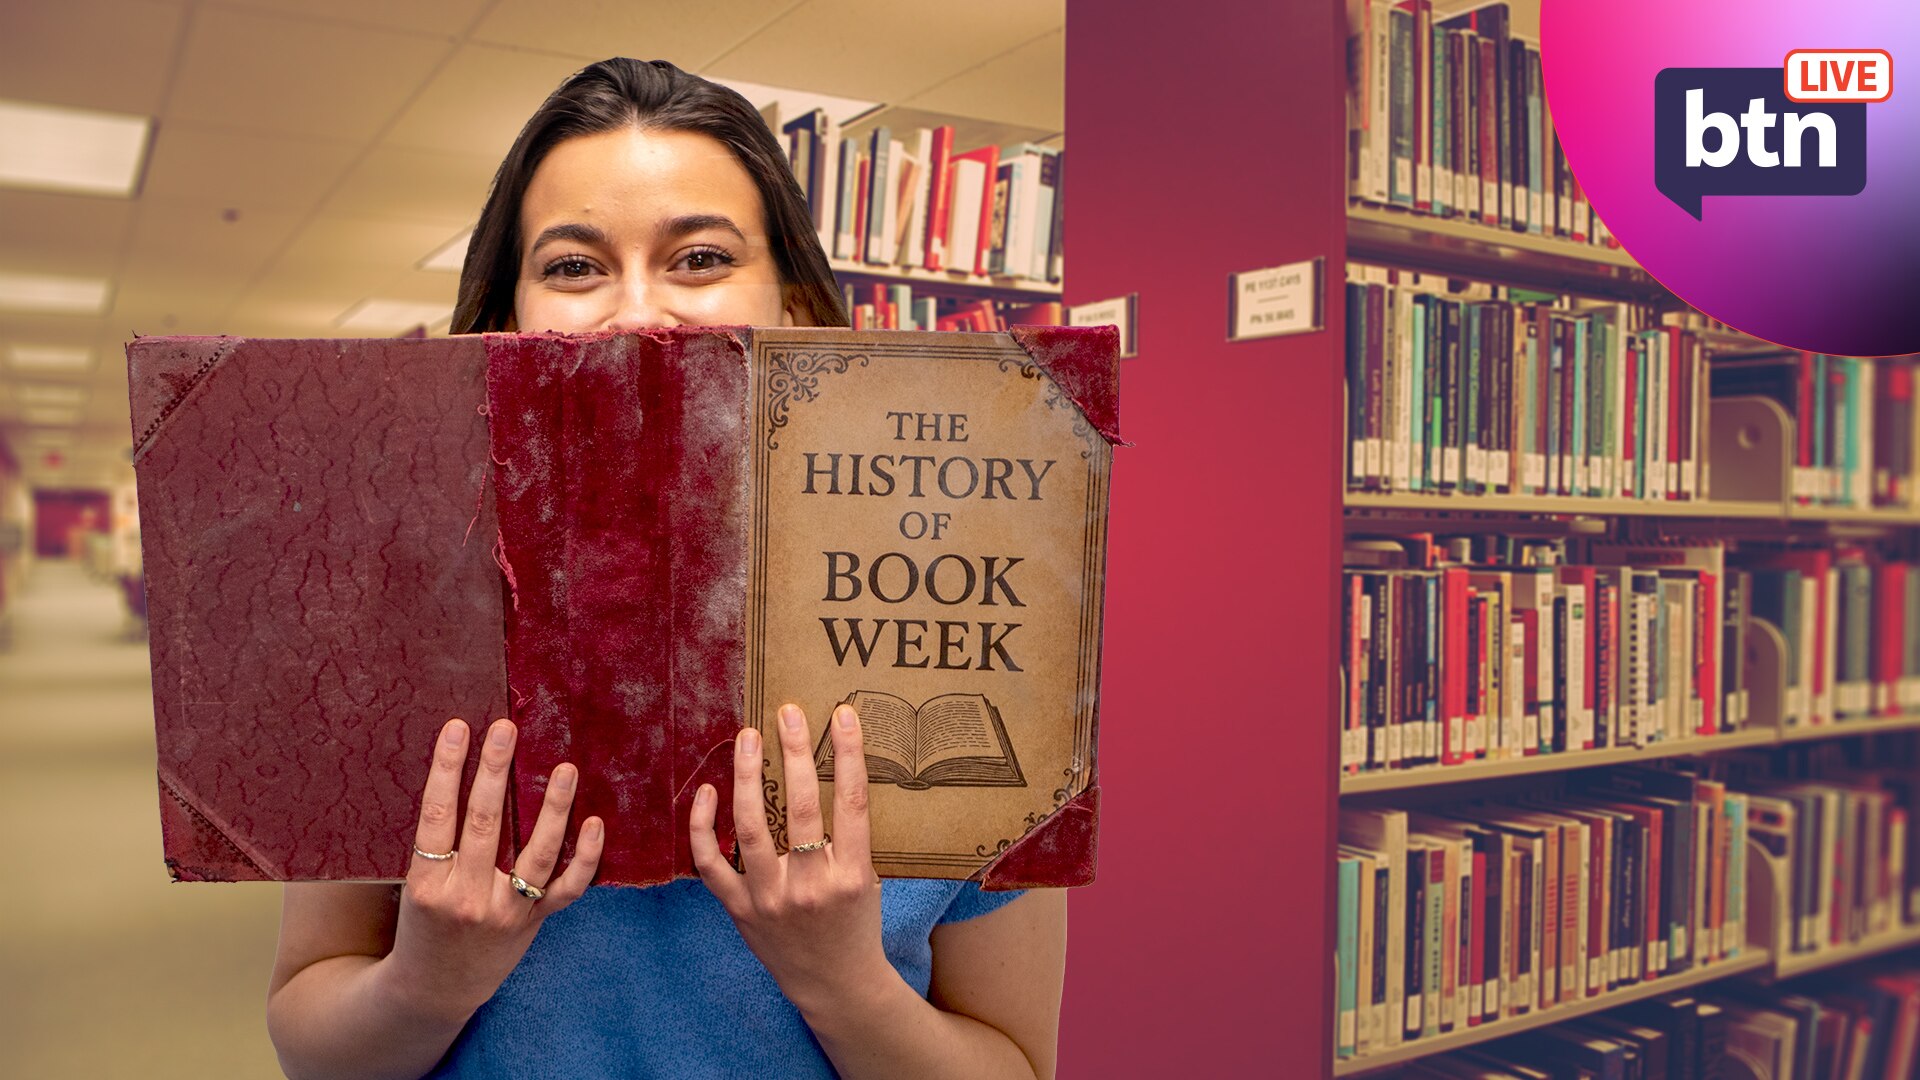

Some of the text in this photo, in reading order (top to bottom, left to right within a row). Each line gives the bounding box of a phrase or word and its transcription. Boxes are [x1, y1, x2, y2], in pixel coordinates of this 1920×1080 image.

[886, 411, 968, 443] THE
[801, 452, 1057, 501] HISTORY
[899, 511, 952, 541] OF
[822, 551, 1027, 608] BOOK
[818, 617, 1025, 673] WEEK
